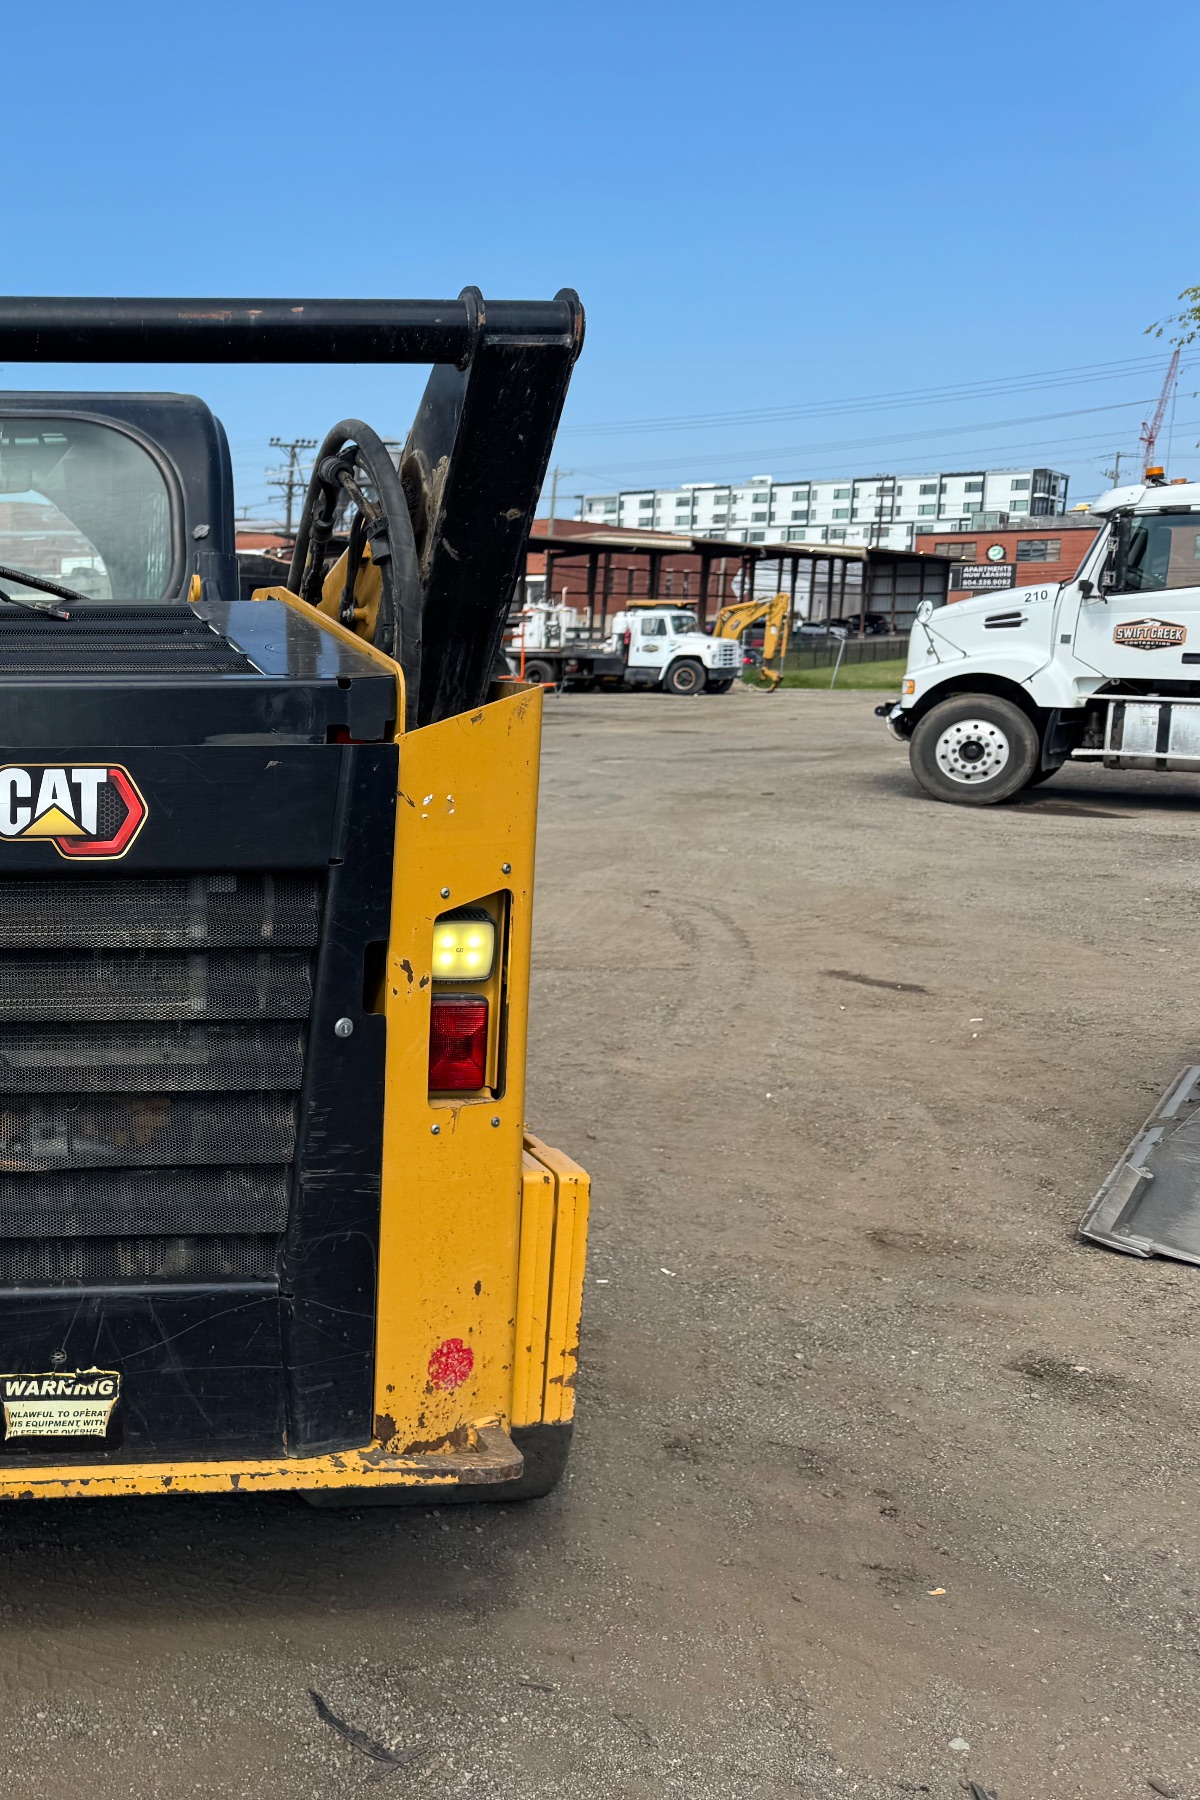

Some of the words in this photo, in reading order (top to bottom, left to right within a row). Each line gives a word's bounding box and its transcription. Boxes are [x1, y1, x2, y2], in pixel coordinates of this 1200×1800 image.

[963, 565, 1012, 573] APARTMENTS
[1024, 590, 1048, 603] 210
[1116, 627, 1150, 640] SWIFT
[1150, 627, 1184, 641] CREEK
[4, 1379, 114, 1397] WARNING
[57, 1410, 70, 1418] TO
[25, 1419, 82, 1428] EQUIPMENT
[83, 1418, 106, 1427] WITH
